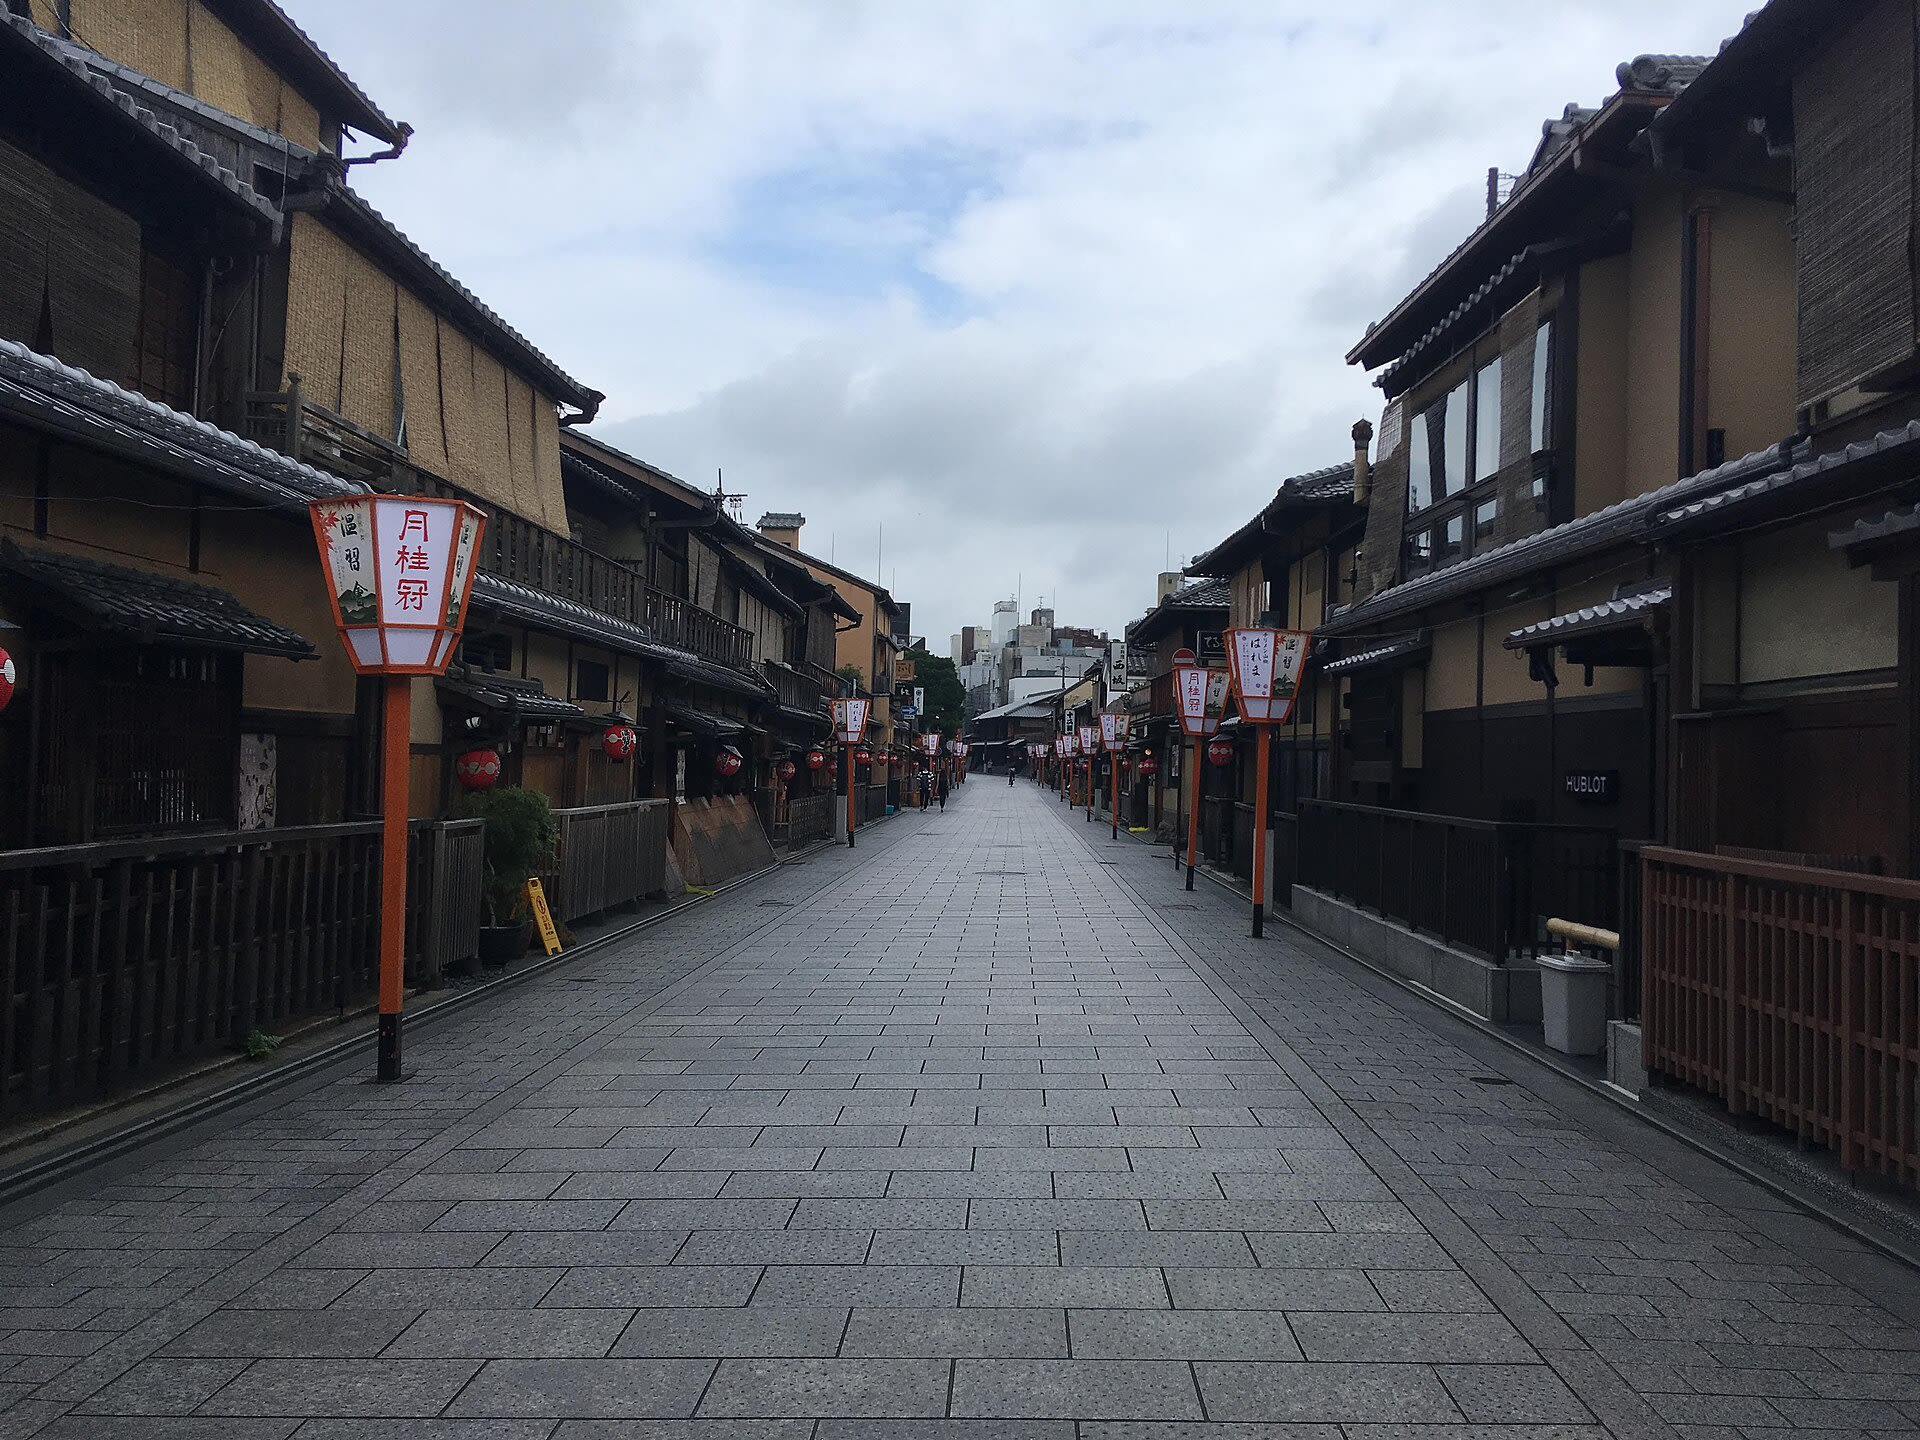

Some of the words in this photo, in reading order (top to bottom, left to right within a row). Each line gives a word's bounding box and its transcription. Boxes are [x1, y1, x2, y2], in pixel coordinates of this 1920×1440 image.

[394, 509, 430, 611] 月桂冠
[1187, 672, 1201, 711] 月桂冠
[1566, 775, 1607, 793] HUBLOT
